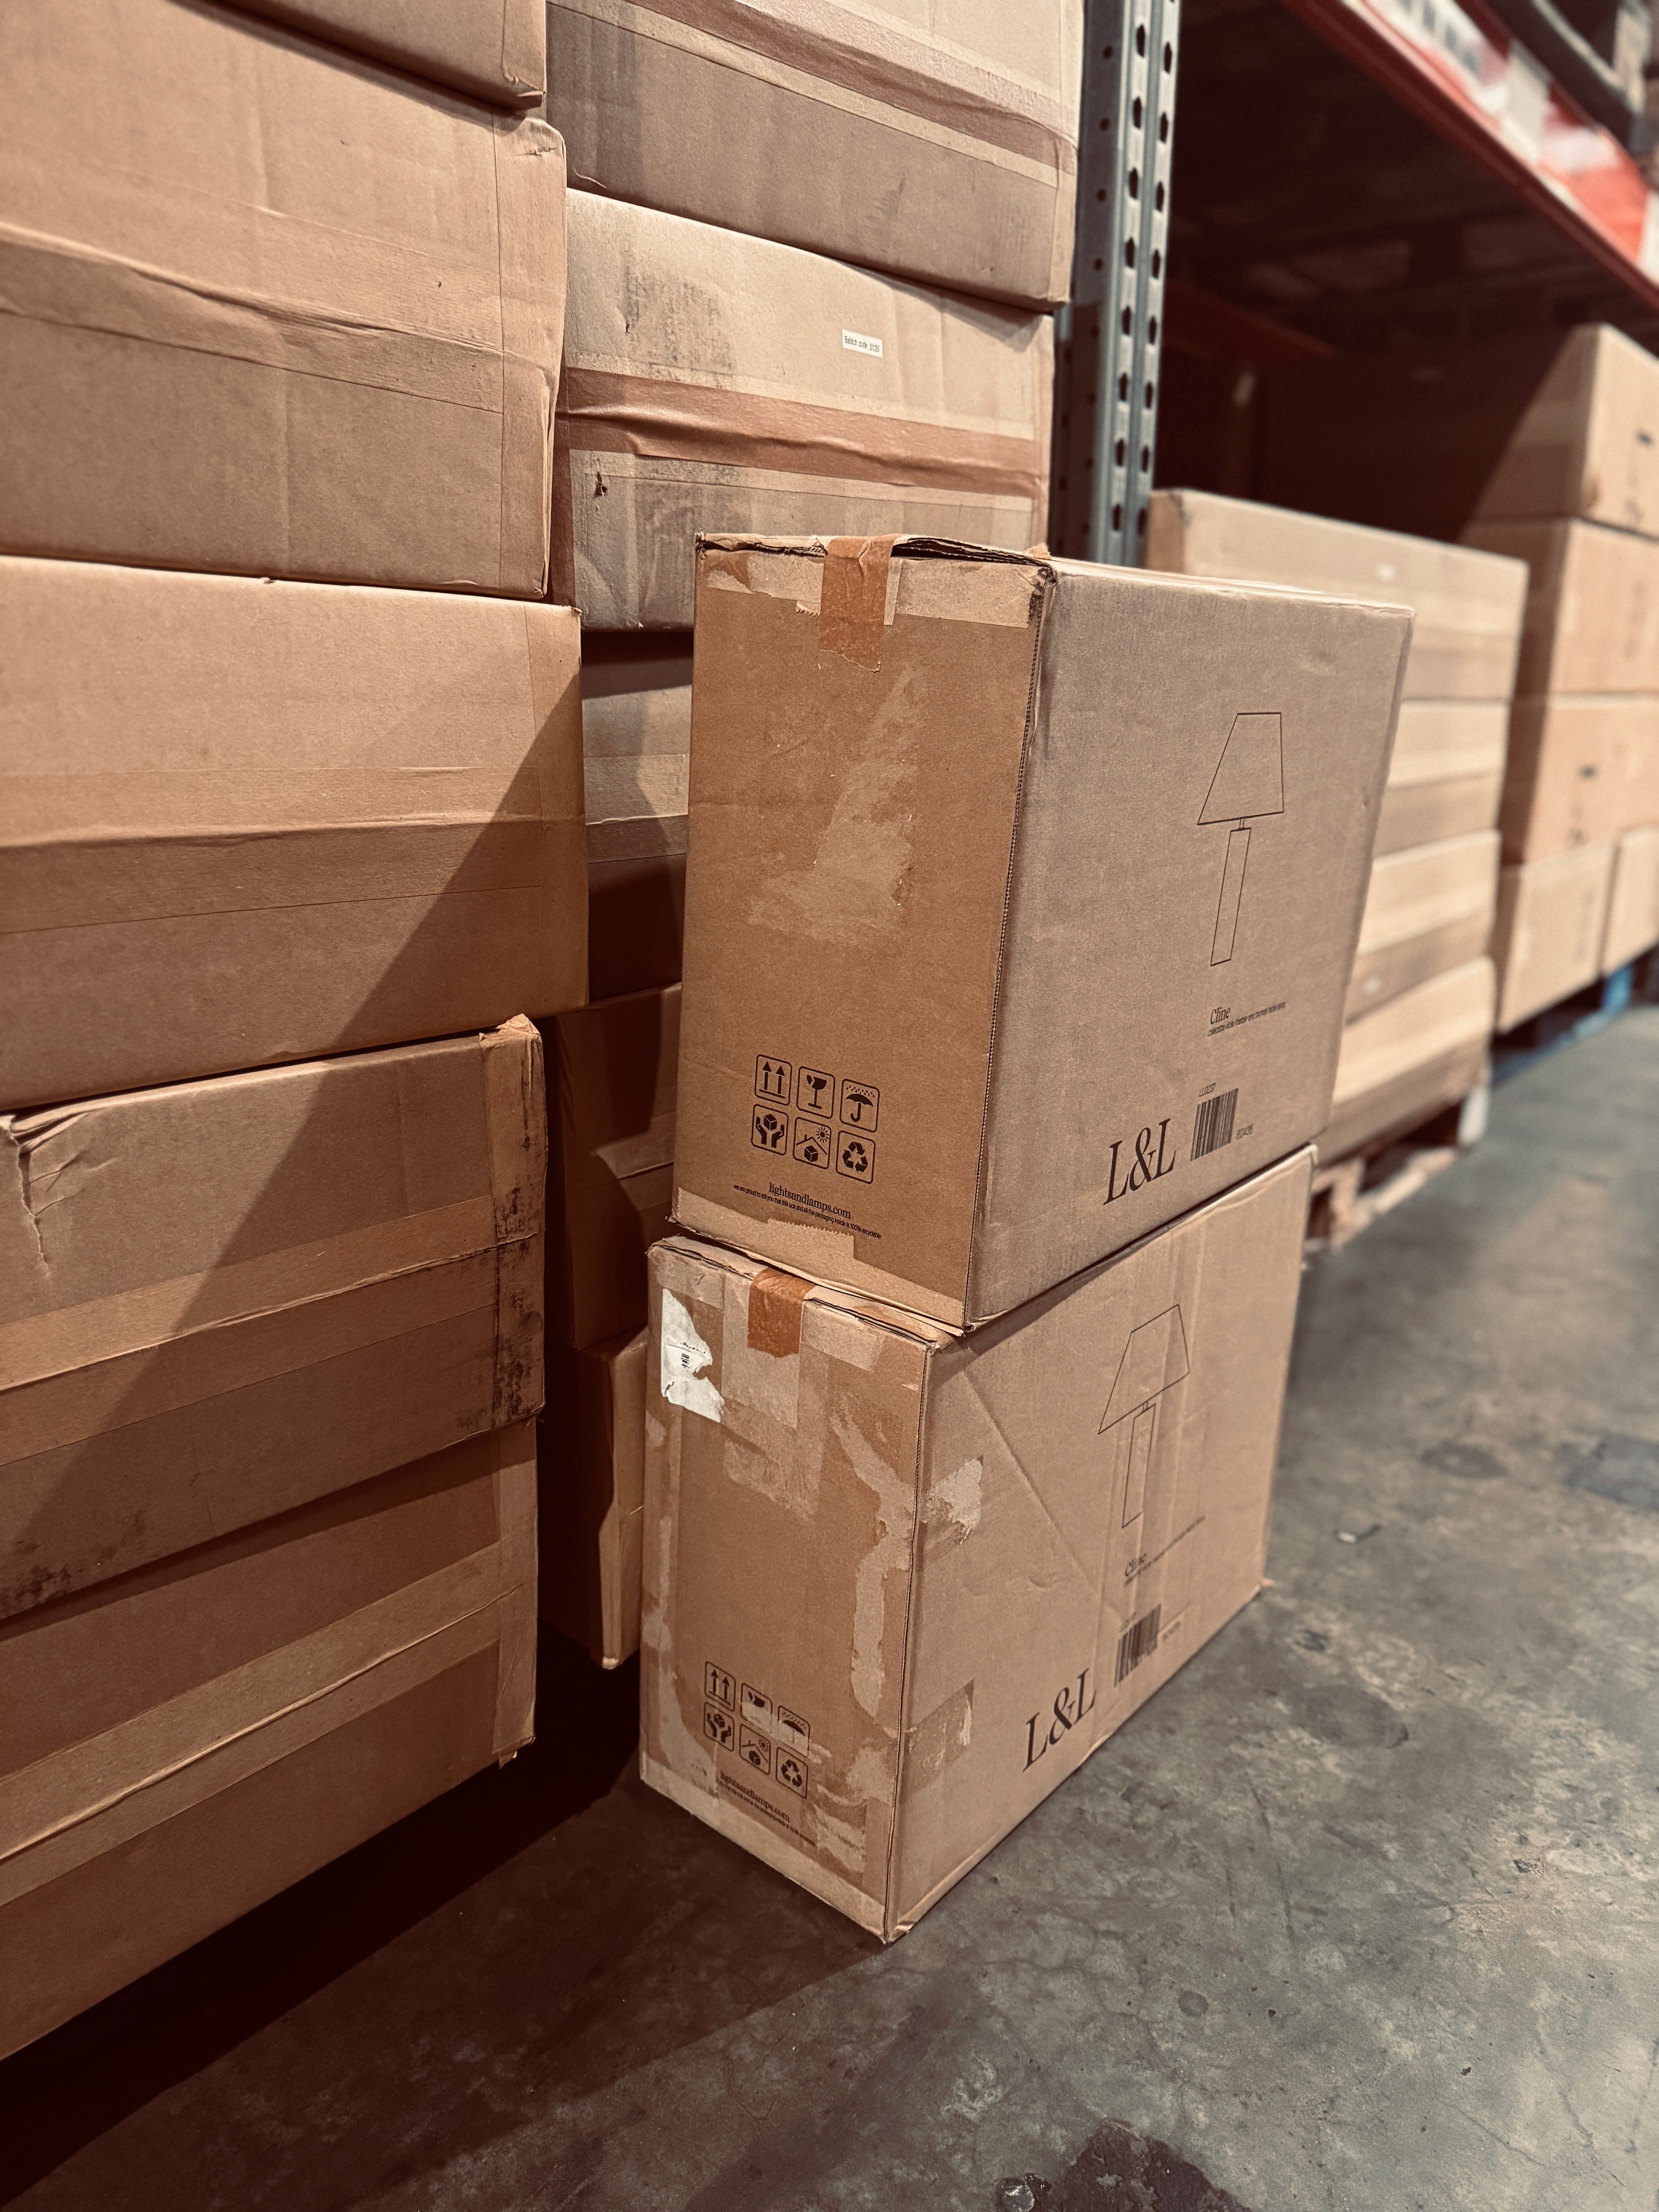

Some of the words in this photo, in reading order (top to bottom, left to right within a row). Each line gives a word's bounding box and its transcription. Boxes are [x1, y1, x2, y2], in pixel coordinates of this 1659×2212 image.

[1210, 1006, 1230, 1025] Cline
[1103, 1118, 1176, 1206] L&L
[769, 1182, 851, 1219] lightsandlamps.com
[815, 1212, 834, 1224] packaging
[834, 1217, 846, 1227] inside
[850, 1223, 861, 1232] 100%
[862, 1228, 881, 1239] recyclable
[1022, 1668, 1097, 1773] L&L
[721, 1770, 790, 1822] lightsandlamps.com
